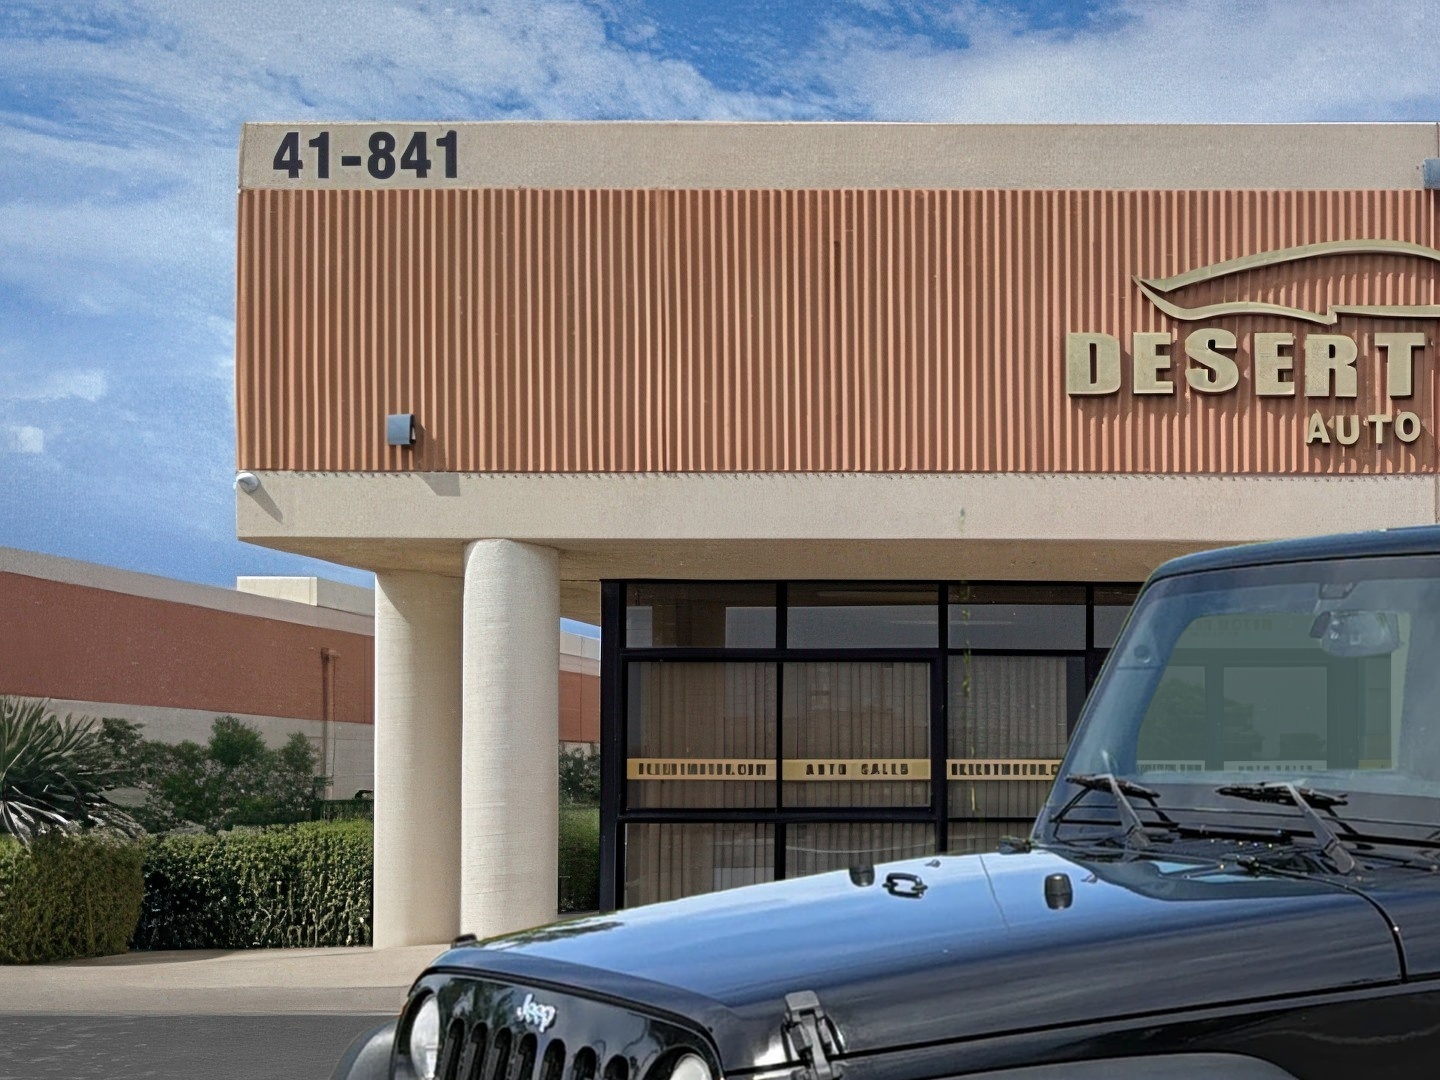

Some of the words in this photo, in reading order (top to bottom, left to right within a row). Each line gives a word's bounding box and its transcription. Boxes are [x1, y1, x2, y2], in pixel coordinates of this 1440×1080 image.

[273, 130, 458, 180] 41-841
[1065, 327, 1426, 398] DESERT
[1305, 410, 1422, 445] AUTO
[516, 993, 557, 1034] Jeep
